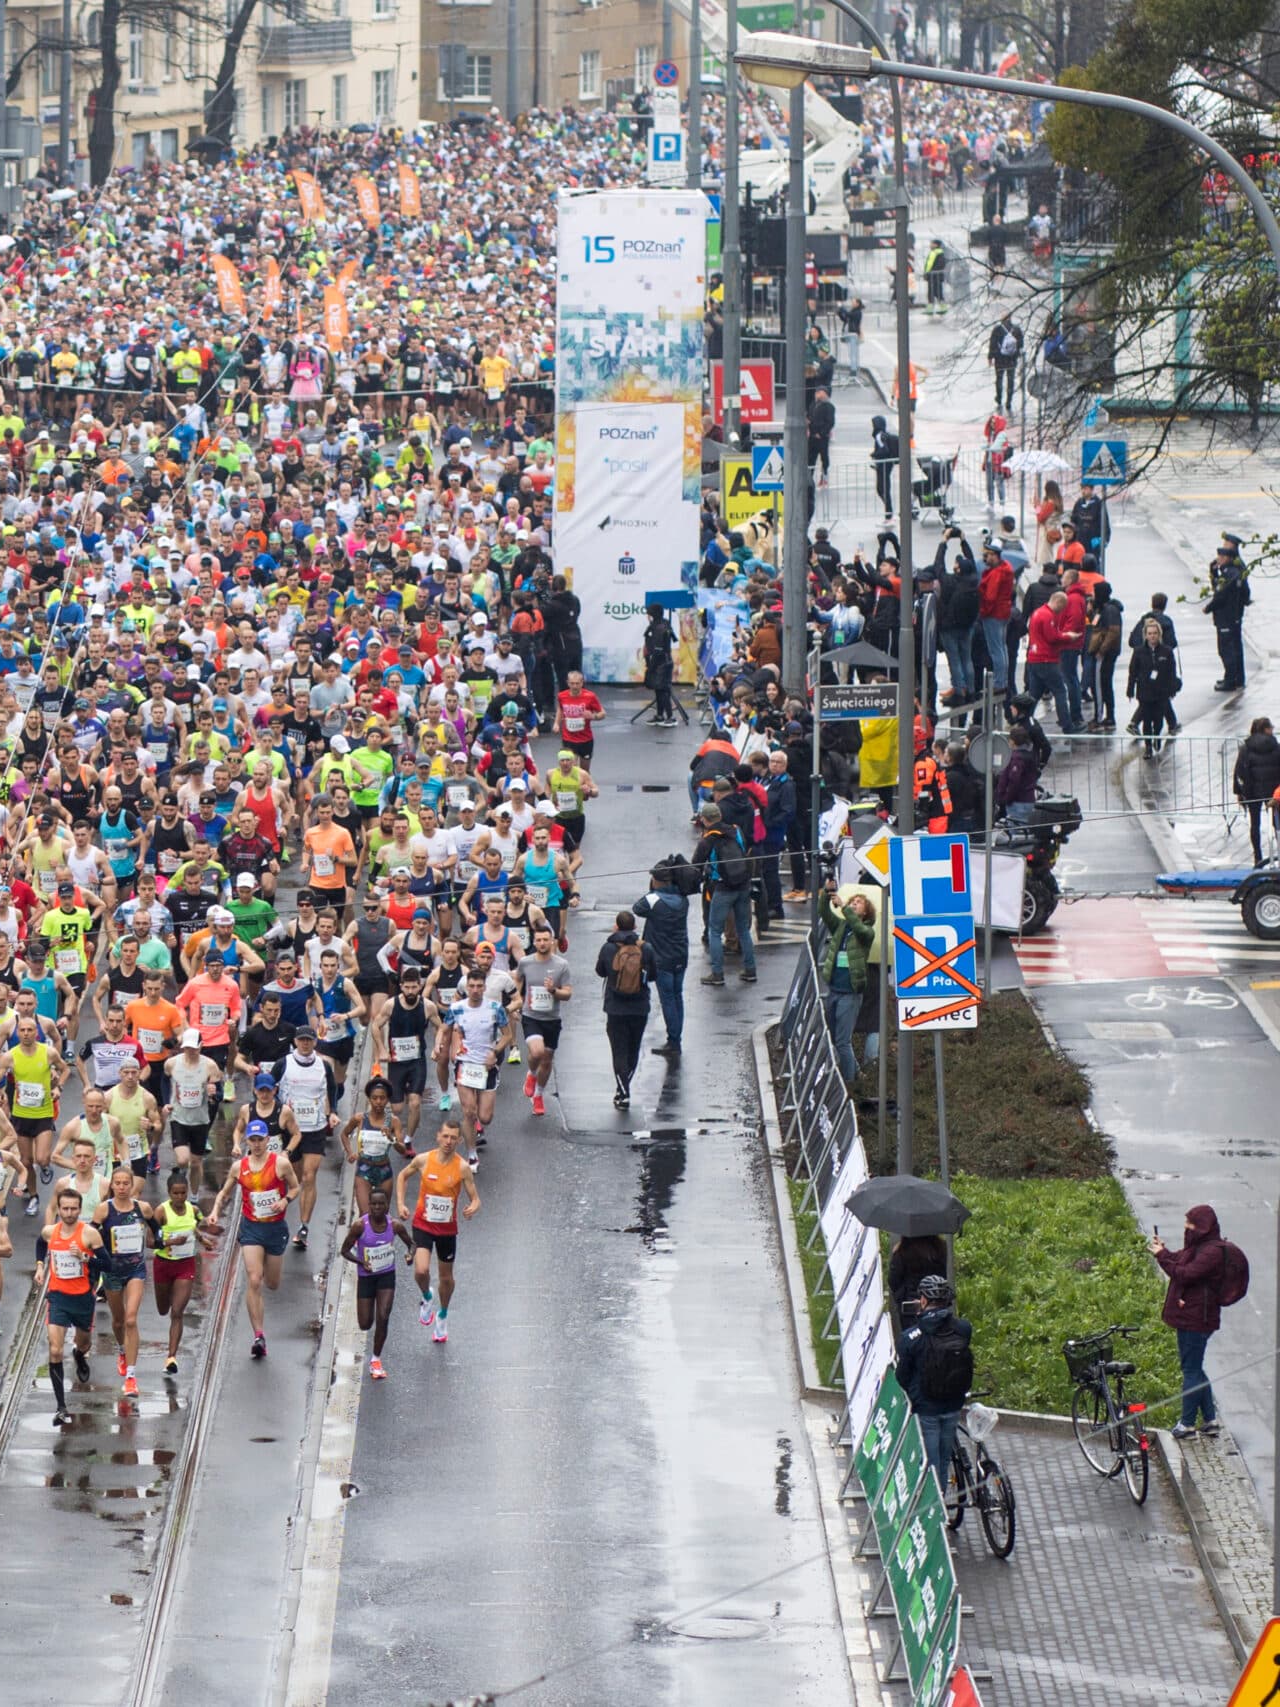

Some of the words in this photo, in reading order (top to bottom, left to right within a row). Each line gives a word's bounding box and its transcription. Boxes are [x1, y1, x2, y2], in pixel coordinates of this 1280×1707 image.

[582, 235, 615, 263] 15
[590, 335, 671, 358] START
[822, 695, 895, 710] Święcickiego
